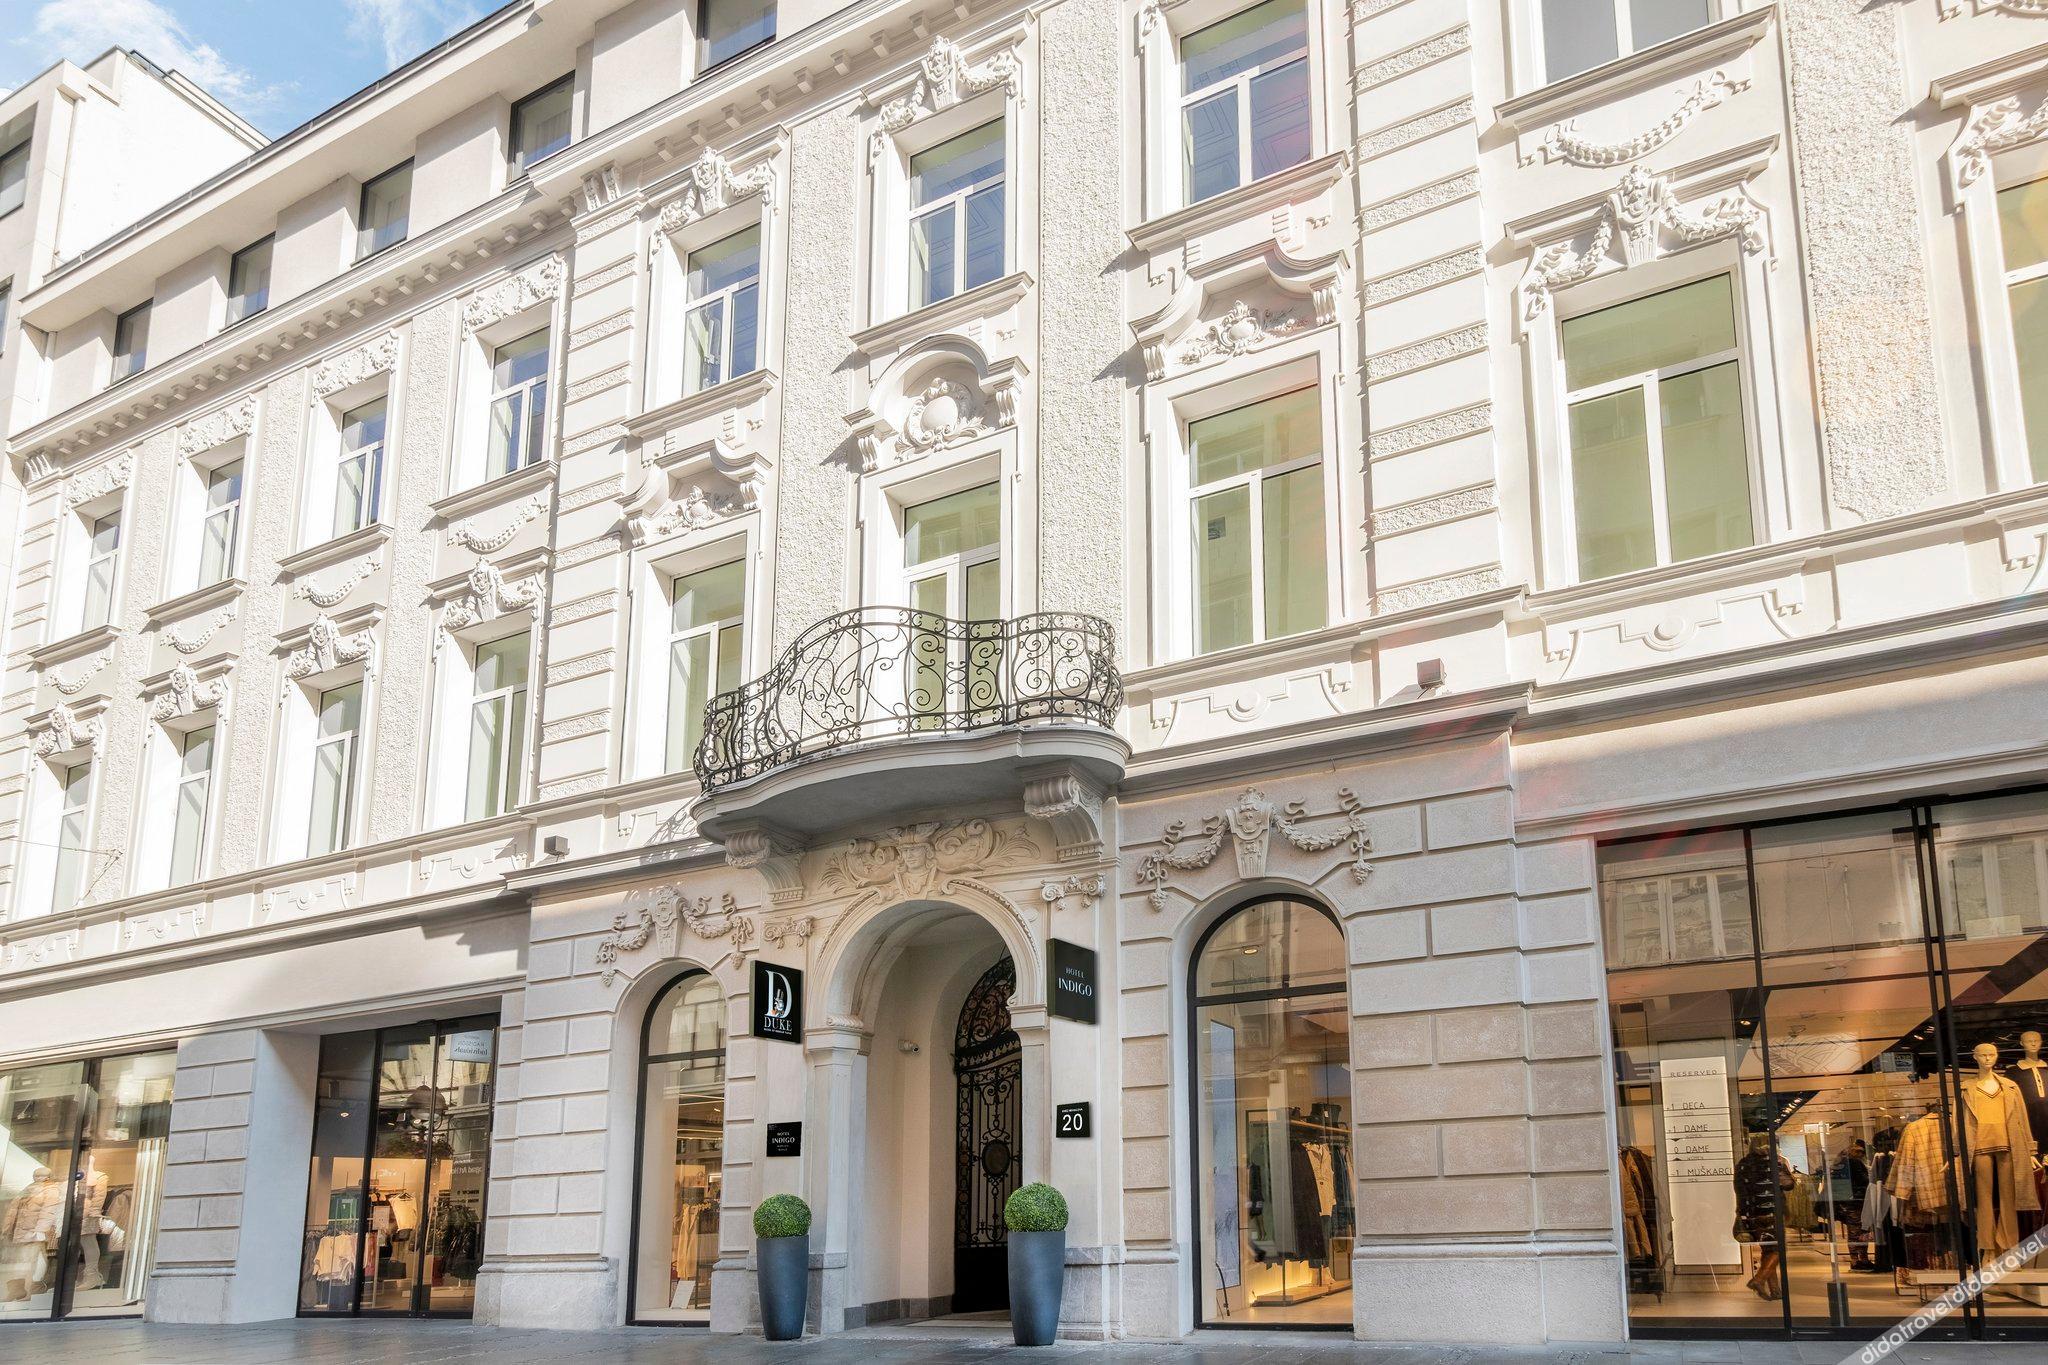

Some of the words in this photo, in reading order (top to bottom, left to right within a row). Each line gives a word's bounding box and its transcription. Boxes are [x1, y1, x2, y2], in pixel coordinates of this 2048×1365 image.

[1065, 967, 1084, 978] HOTEL
[1058, 977, 1092, 997] INDIGO
[764, 1016, 793, 1032] DUKE
[1670, 1069, 1718, 1078] RESERVED
[1682, 1102, 1706, 1110] DECA
[1062, 1113, 1083, 1131] 20
[1684, 1124, 1710, 1133] DAME
[771, 1136, 796, 1144] INDIGO
[1685, 1145, 1710, 1154] DAME
[1687, 1166, 1732, 1176] MUŠKARCI
